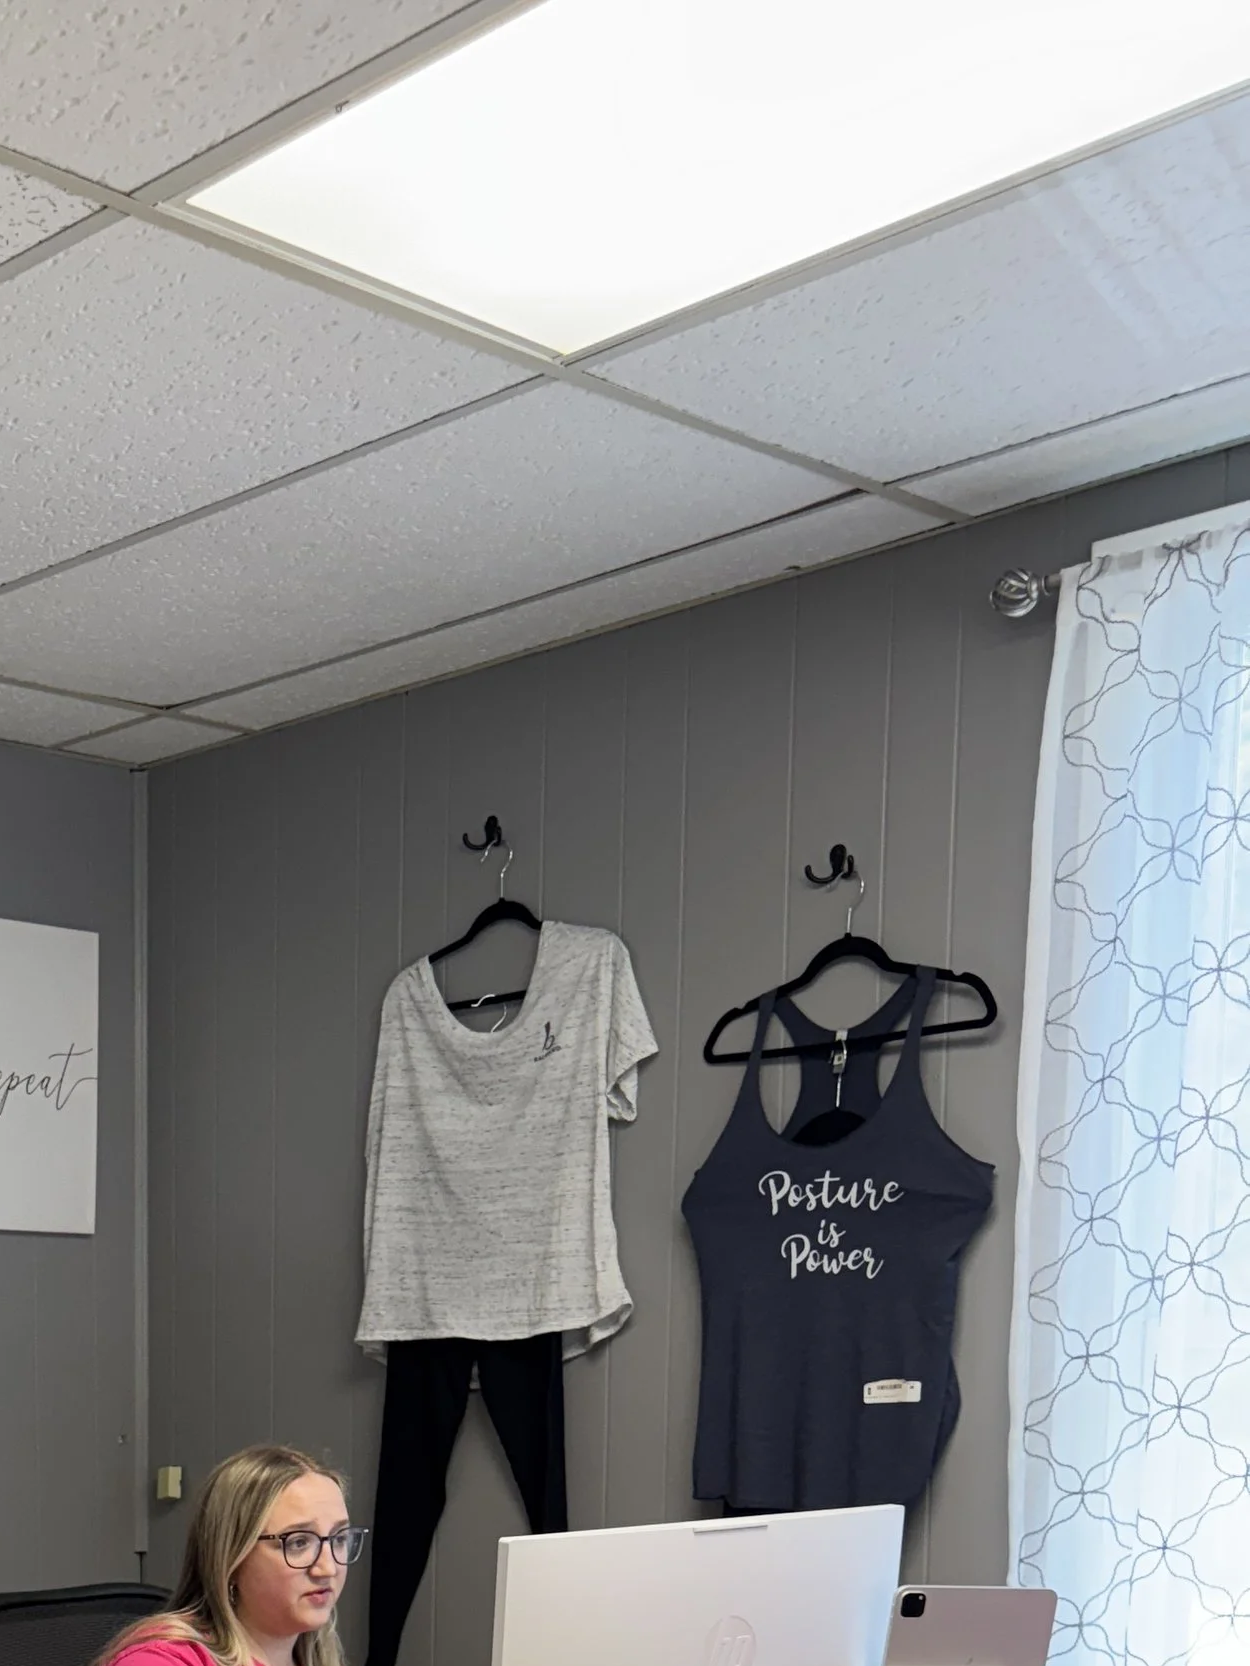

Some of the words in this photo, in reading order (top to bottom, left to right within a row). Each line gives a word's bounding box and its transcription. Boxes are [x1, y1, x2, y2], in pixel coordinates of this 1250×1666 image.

[758, 1170, 904, 1216] Posture
[817, 1219, 846, 1248] is
[781, 1234, 884, 1279] Power
